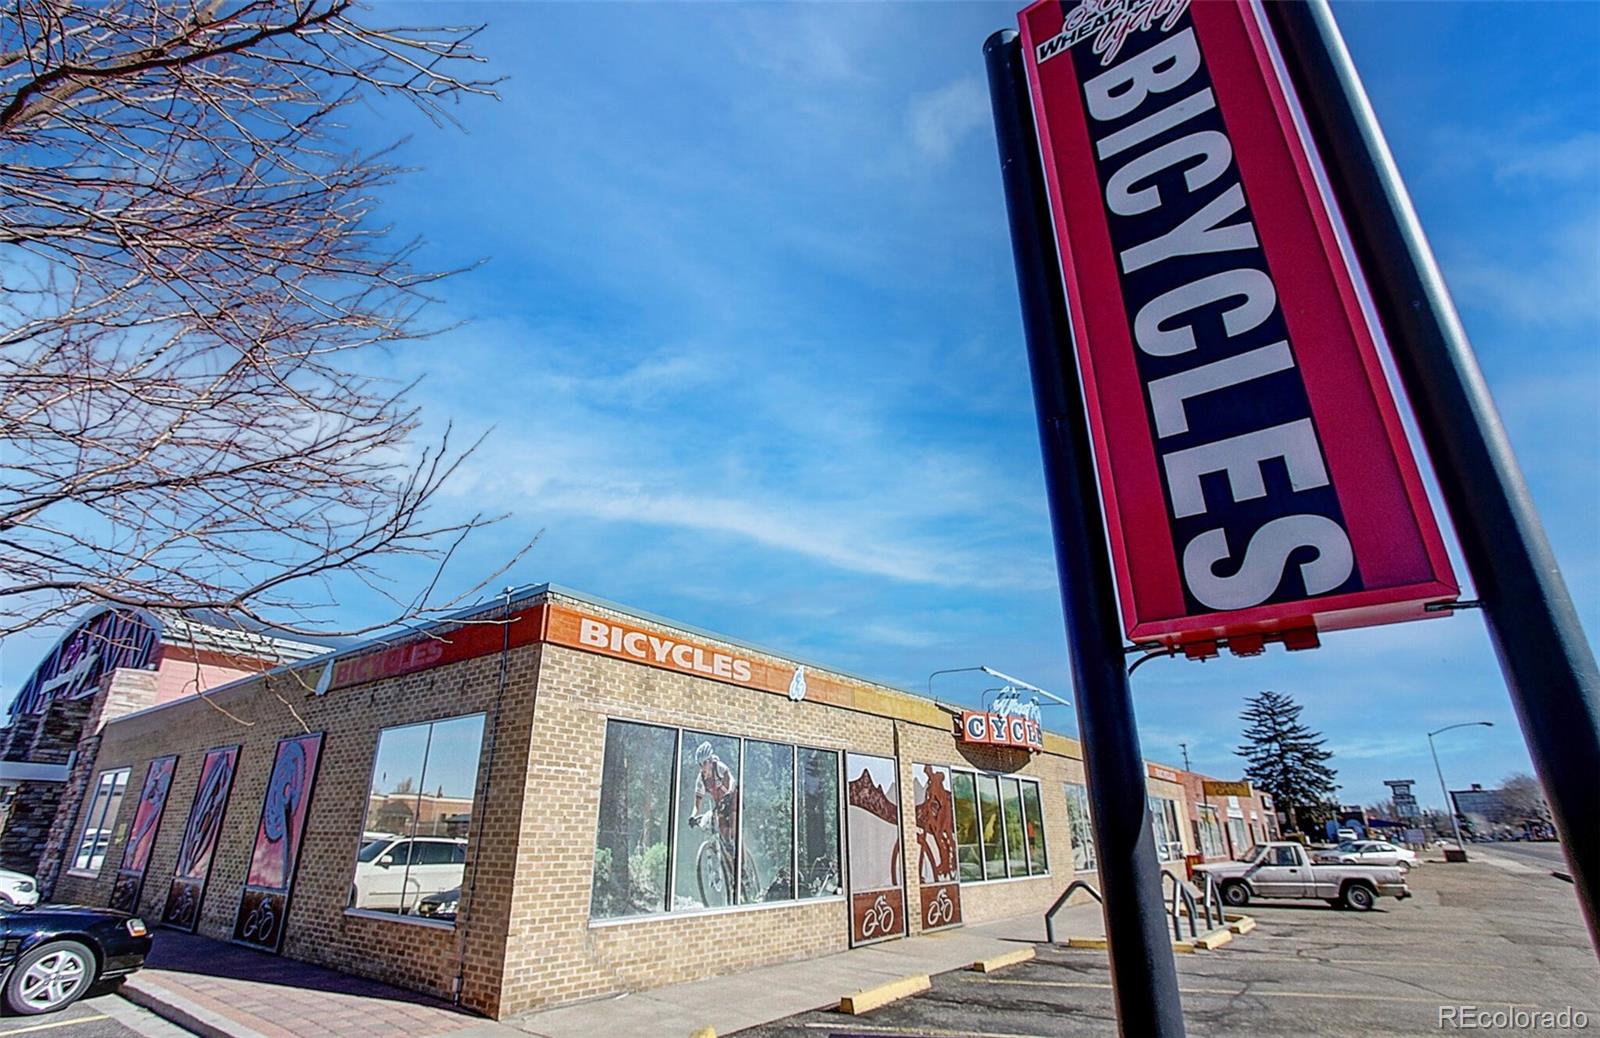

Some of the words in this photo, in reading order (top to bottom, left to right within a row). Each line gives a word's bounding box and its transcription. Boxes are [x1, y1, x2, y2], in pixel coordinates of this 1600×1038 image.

[1083, 27, 1353, 610] BICYCLES
[336, 640, 444, 684] BICYCLES
[580, 617, 751, 682] BICYCLES
